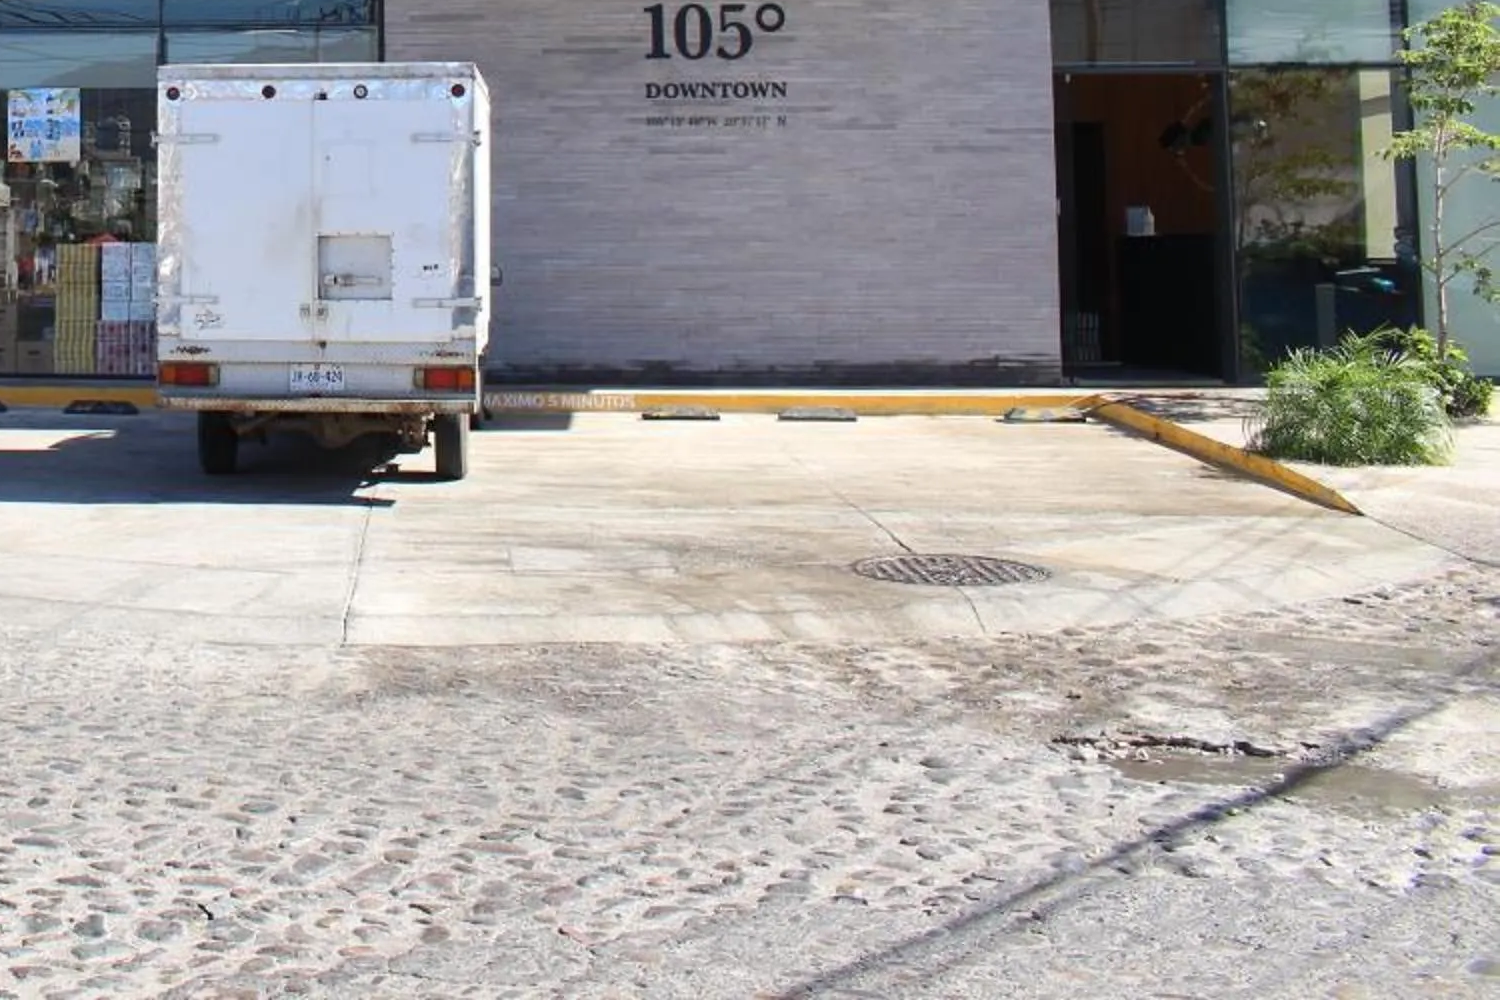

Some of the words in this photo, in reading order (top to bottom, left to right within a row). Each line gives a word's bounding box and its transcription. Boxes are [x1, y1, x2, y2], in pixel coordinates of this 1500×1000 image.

[645, 82, 787, 99] DOWNTOWN
[547, 393, 558, 407] 5
[561, 393, 635, 409] MINUTOS
